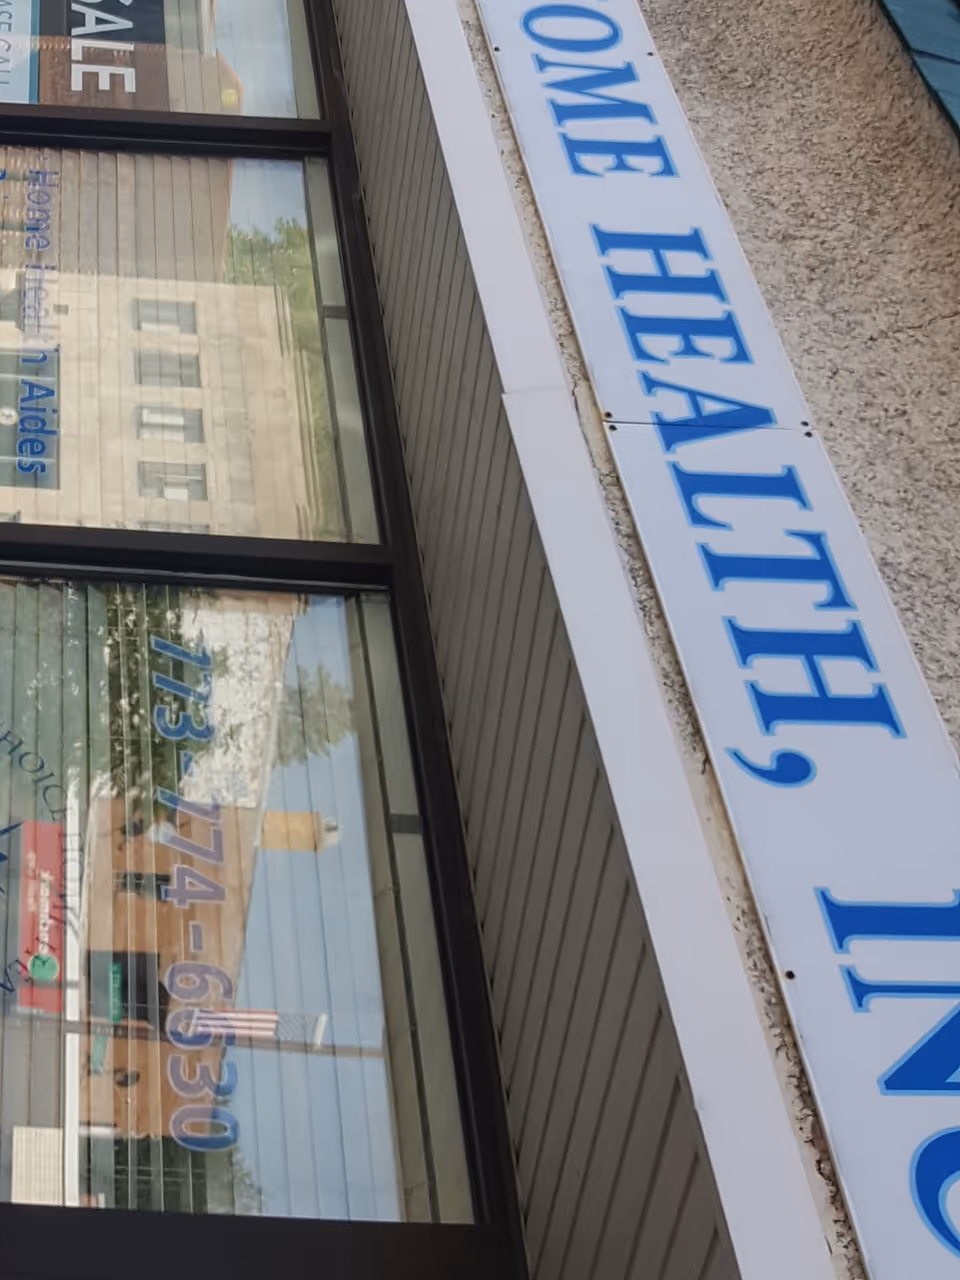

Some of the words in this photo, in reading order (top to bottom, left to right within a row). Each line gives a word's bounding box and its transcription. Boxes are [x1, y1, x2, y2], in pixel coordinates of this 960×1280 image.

[24, 170, 58, 251] Home
[16, 379, 58, 474] Aides
[588, 223, 906, 789] HEALTH,
[814, 886, 960, 1258] IN
